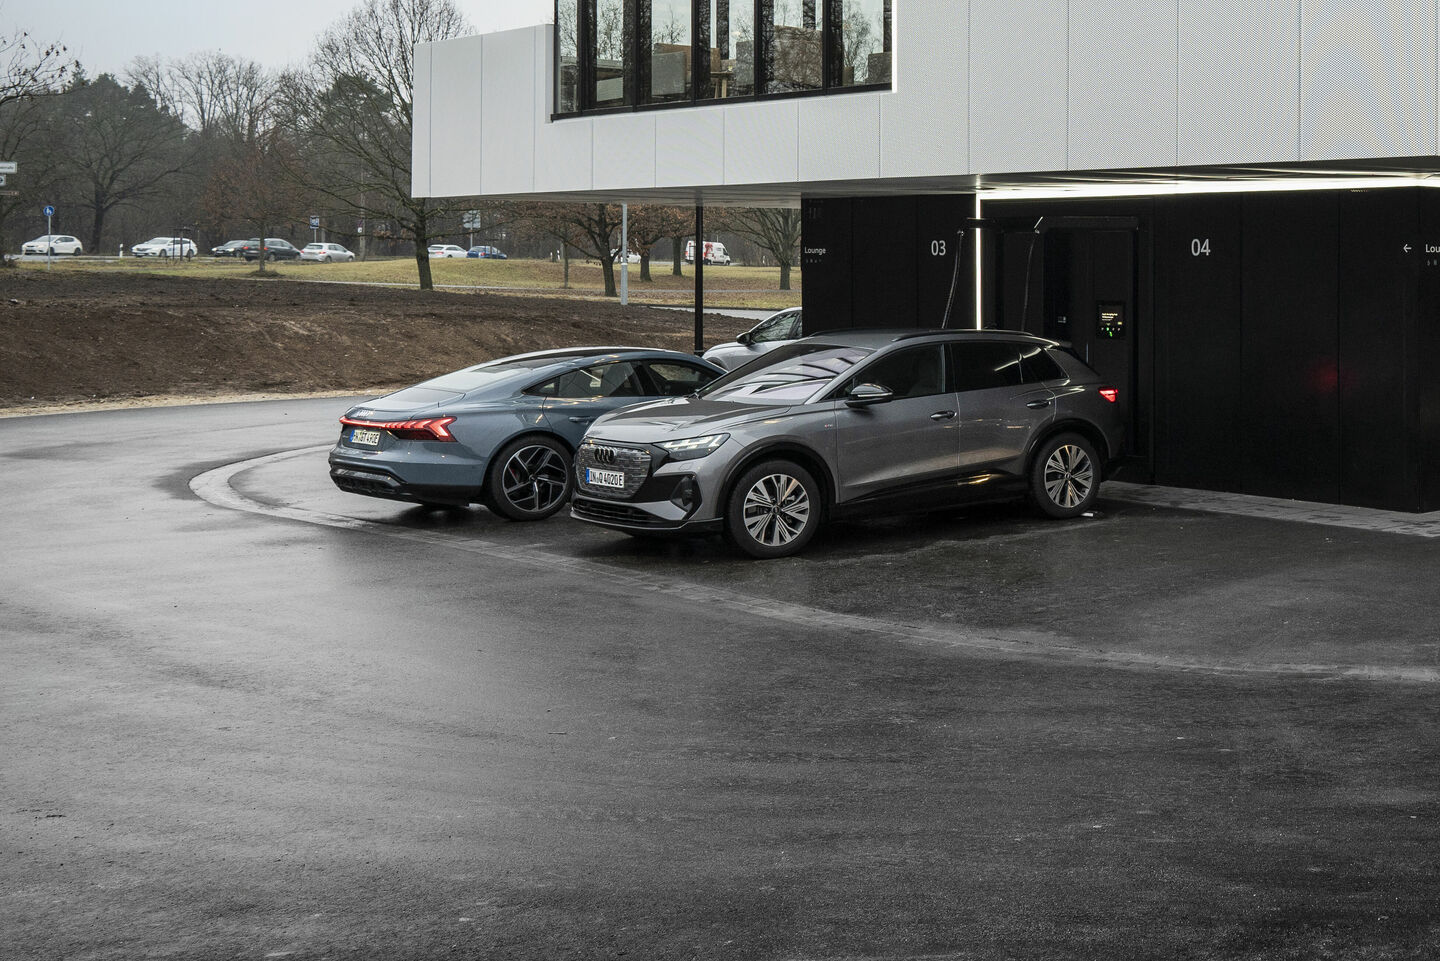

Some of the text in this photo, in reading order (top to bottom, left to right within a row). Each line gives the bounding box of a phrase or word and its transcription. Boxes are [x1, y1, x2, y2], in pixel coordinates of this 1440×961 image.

[804, 246, 827, 256] Lounge
[930, 239, 946, 256] 03
[1191, 238, 1211, 257] 04
